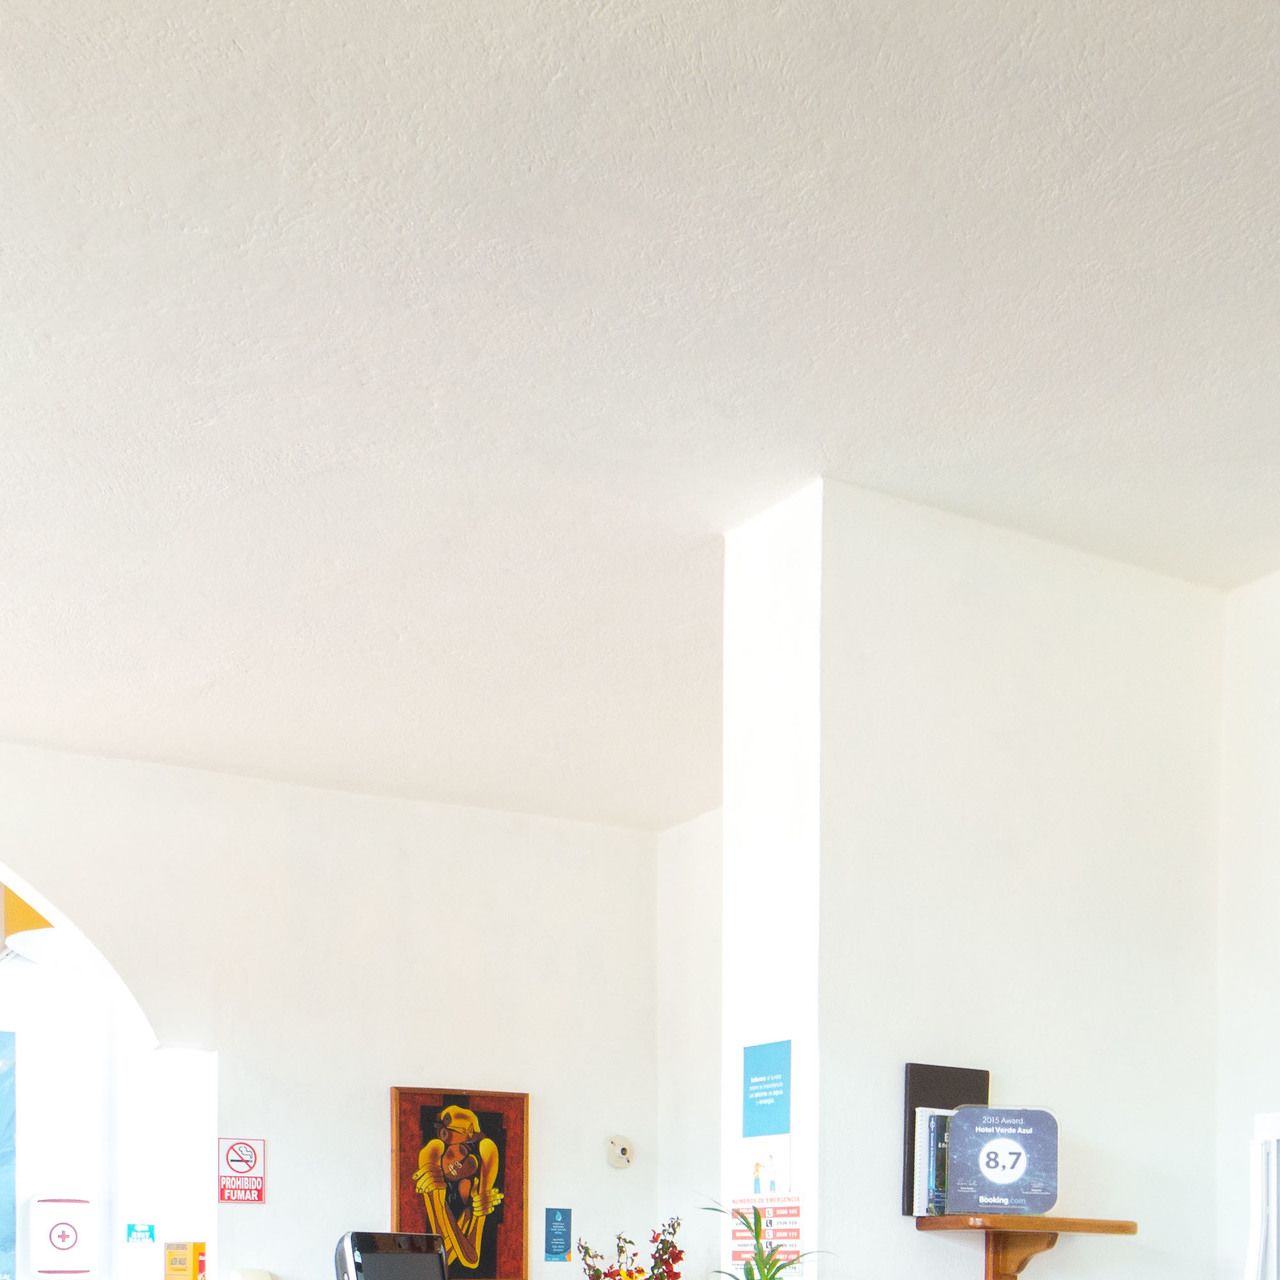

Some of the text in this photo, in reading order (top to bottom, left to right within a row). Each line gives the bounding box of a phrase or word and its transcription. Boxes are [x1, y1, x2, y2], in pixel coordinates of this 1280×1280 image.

[982, 1115, 1024, 1125] 2015 Award
[975, 1126, 994, 1134] Hotel
[995, 1126, 1016, 1134] Verde
[985, 1151, 1022, 1172] 8,7
[221, 1176, 262, 1190] PROHIBIDO
[224, 1189, 259, 1201] FUMAR
[978, 1195, 1026, 1205] Booking.com
